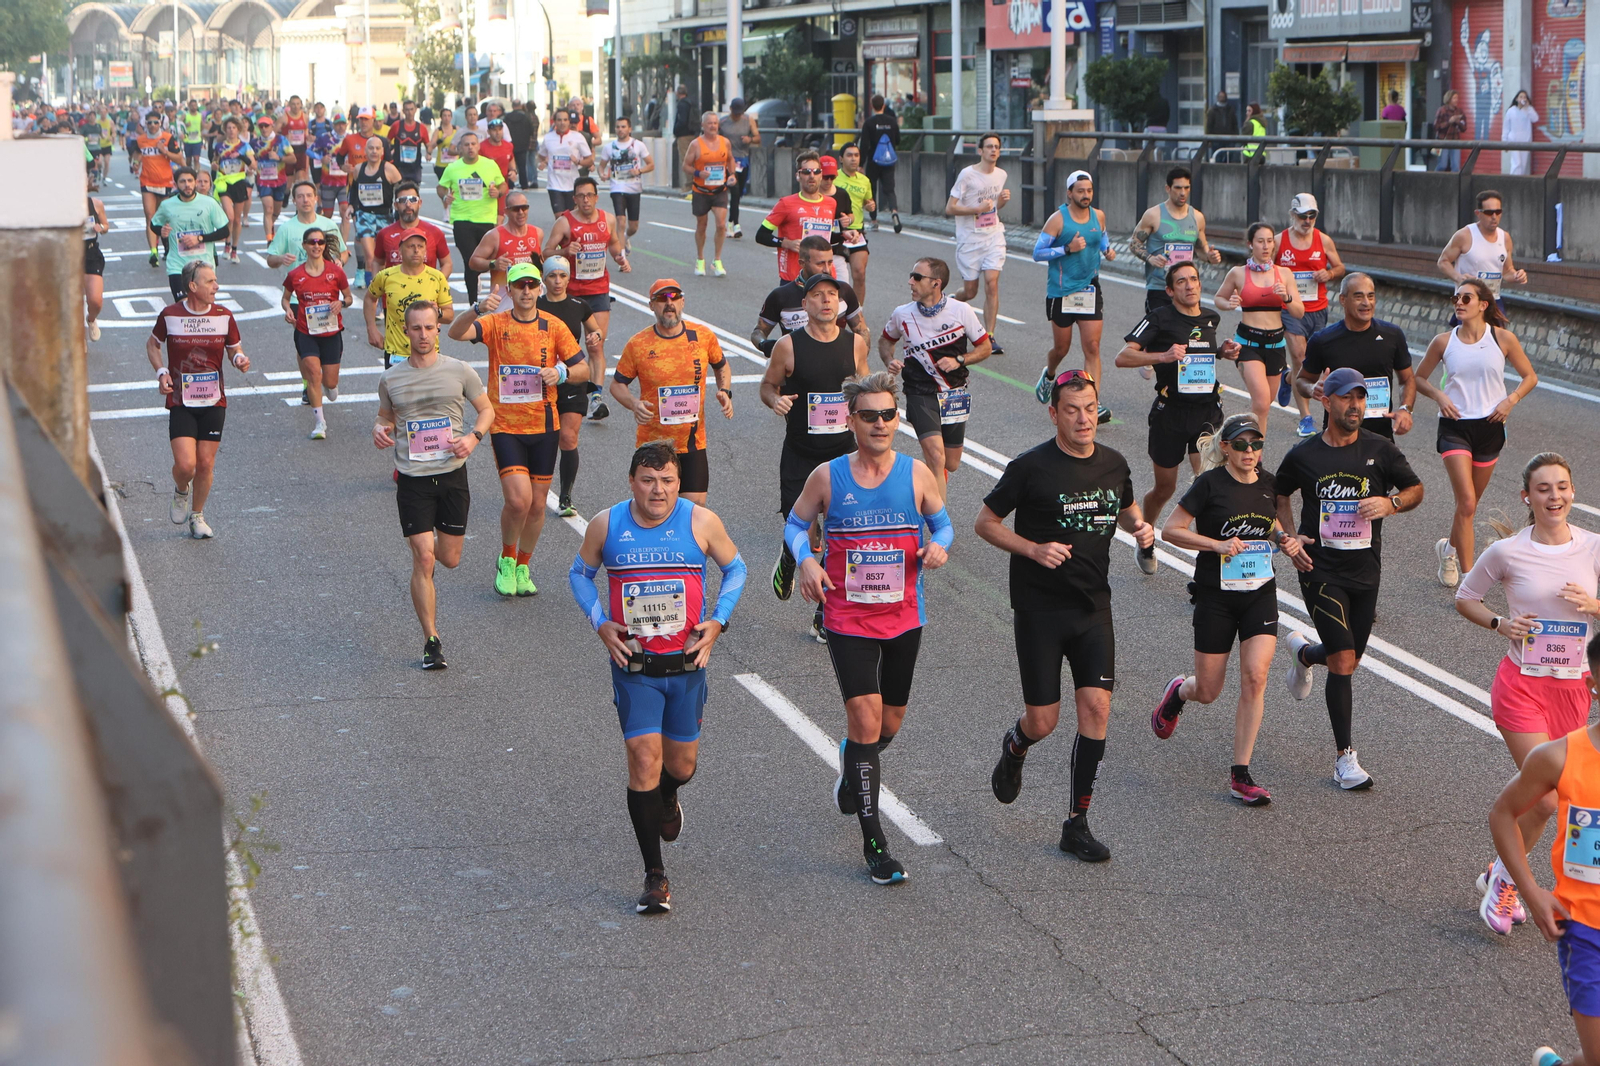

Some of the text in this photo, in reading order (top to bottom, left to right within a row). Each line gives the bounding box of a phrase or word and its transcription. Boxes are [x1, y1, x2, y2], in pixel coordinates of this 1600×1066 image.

[824, 395, 845, 403] ZURIC
[422, 420, 446, 428] ZURICH
[1319, 472, 1362, 483] Nature Runners
[1063, 501, 1098, 512] FINISHER
[842, 512, 905, 527] CREDUS
[1229, 513, 1249, 523] Nature
[616, 552, 685, 564] CREDUS
[644, 585, 676, 593] ZURICH
[642, 603, 667, 612] 11115
[633, 613, 678, 624] ANTONIO JOSÉ
[1547, 624, 1579, 634] ZURICH
[1546, 644, 1565, 652] 8365
[1540, 656, 1570, 665] CHARLOT
[856, 762, 873, 817] kalenji
